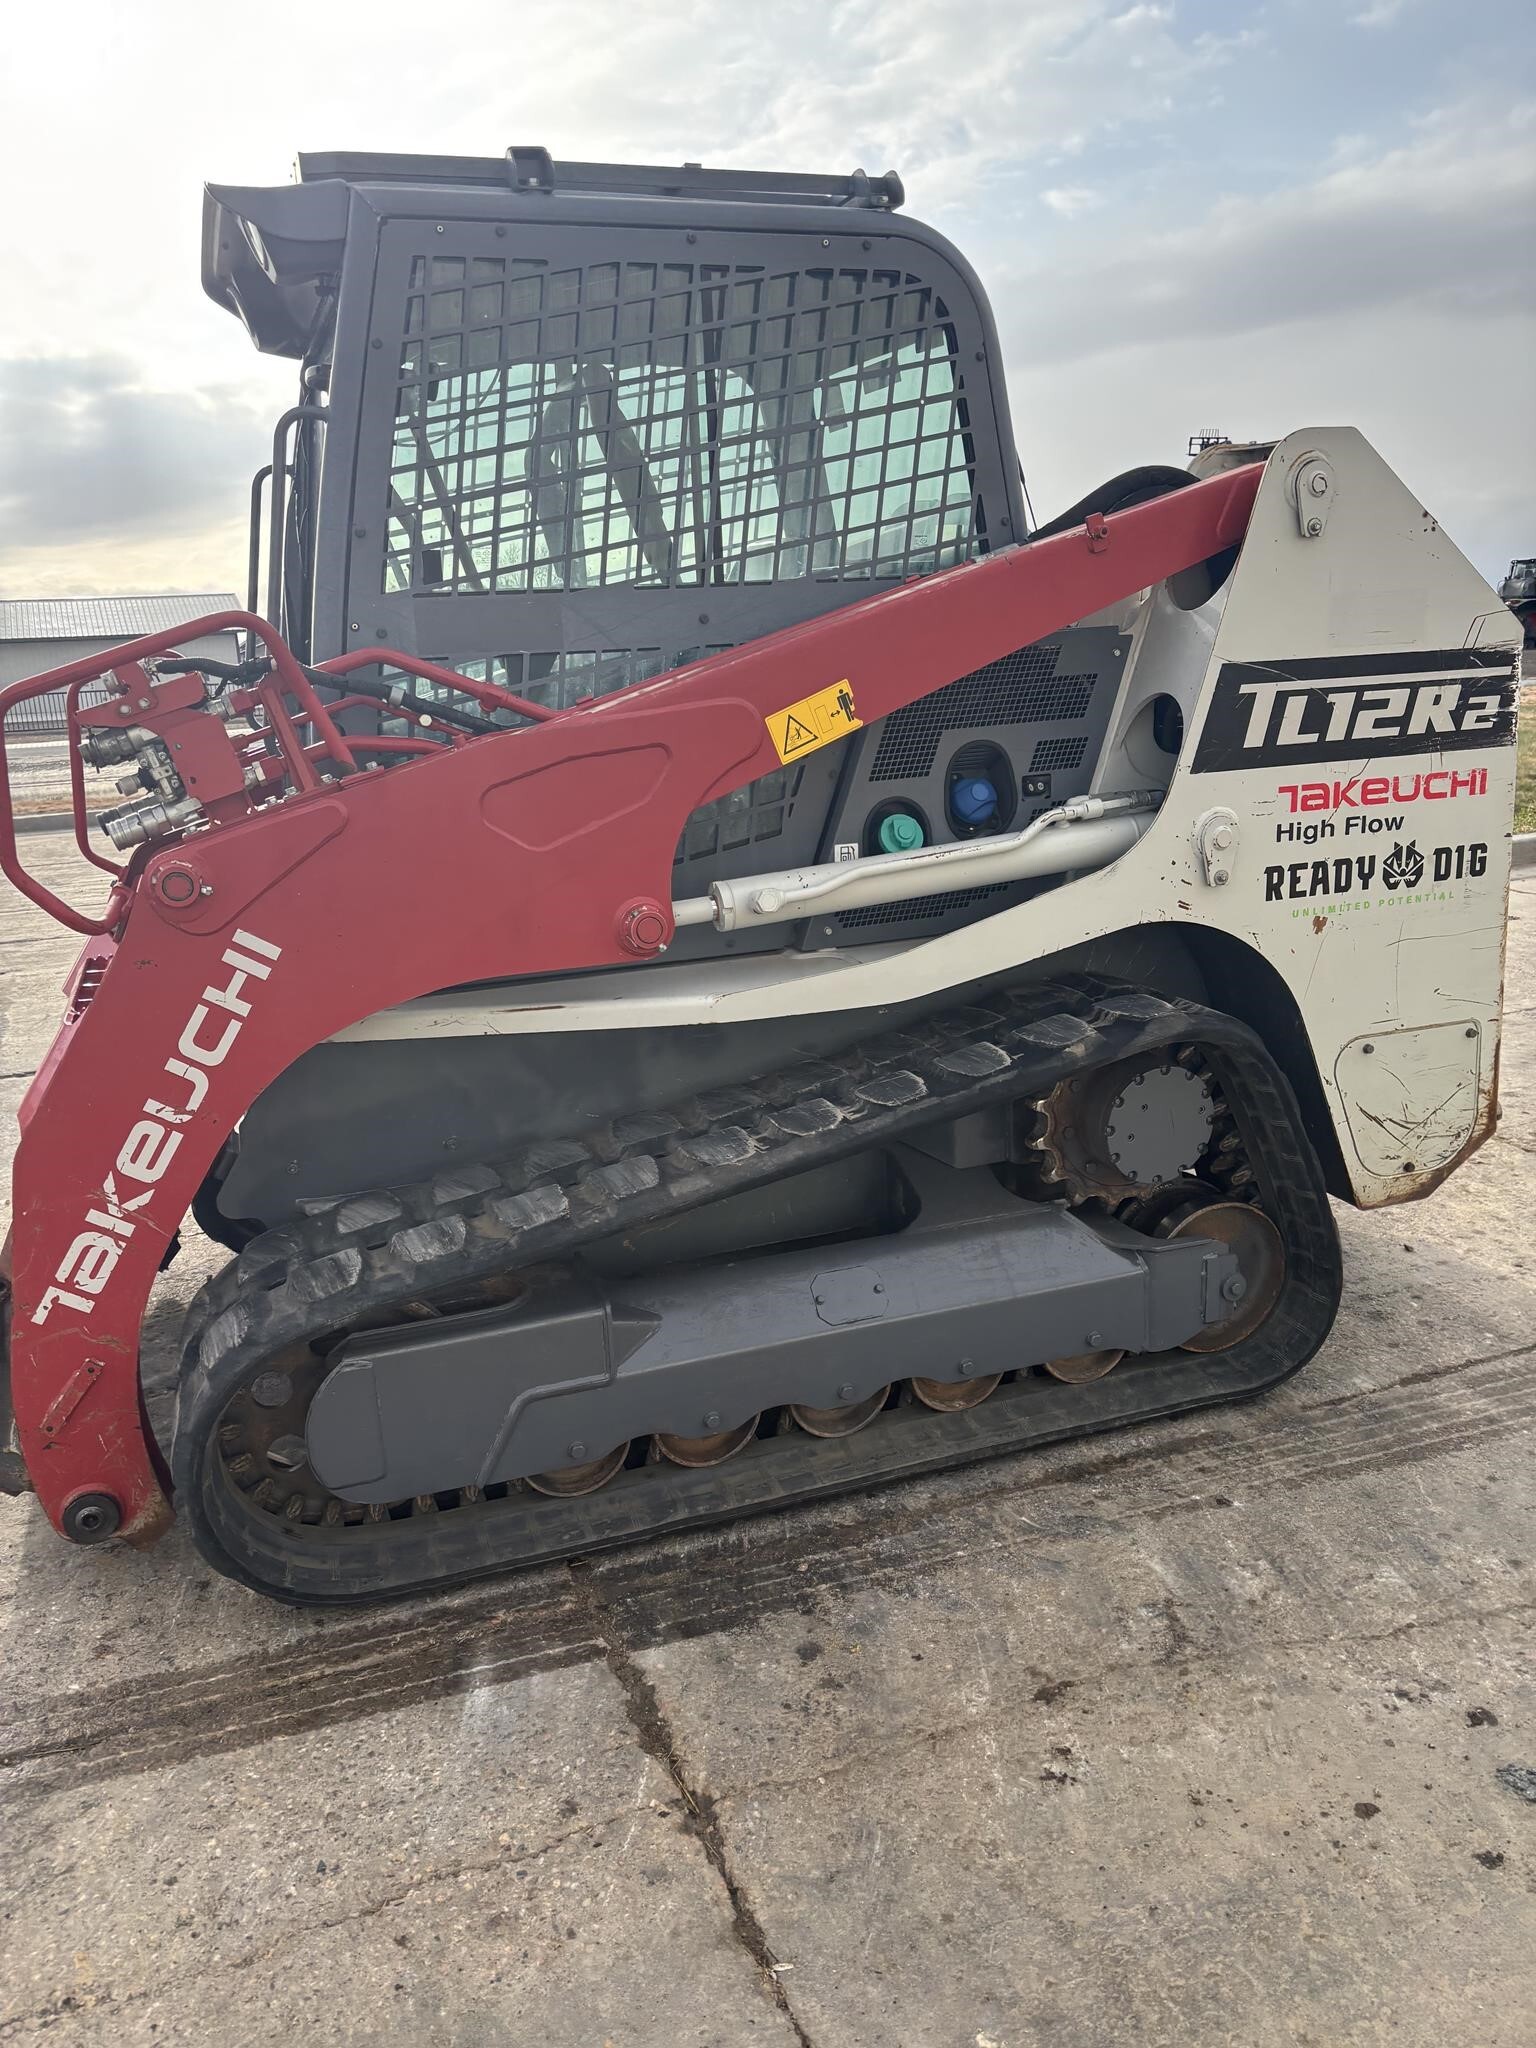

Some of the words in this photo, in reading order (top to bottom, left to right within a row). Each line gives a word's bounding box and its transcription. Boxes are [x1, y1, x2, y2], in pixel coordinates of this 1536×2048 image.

[1239, 676, 1501, 749] TL12R2
[1276, 820, 1335, 844] High
[1345, 815, 1405, 836] Flow
[1264, 855, 1376, 902] READY
[1433, 842, 1488, 882] DIG
[1292, 901, 1371, 918] UNLIMITED
[1378, 891, 1455, 907] POTENTIAL
